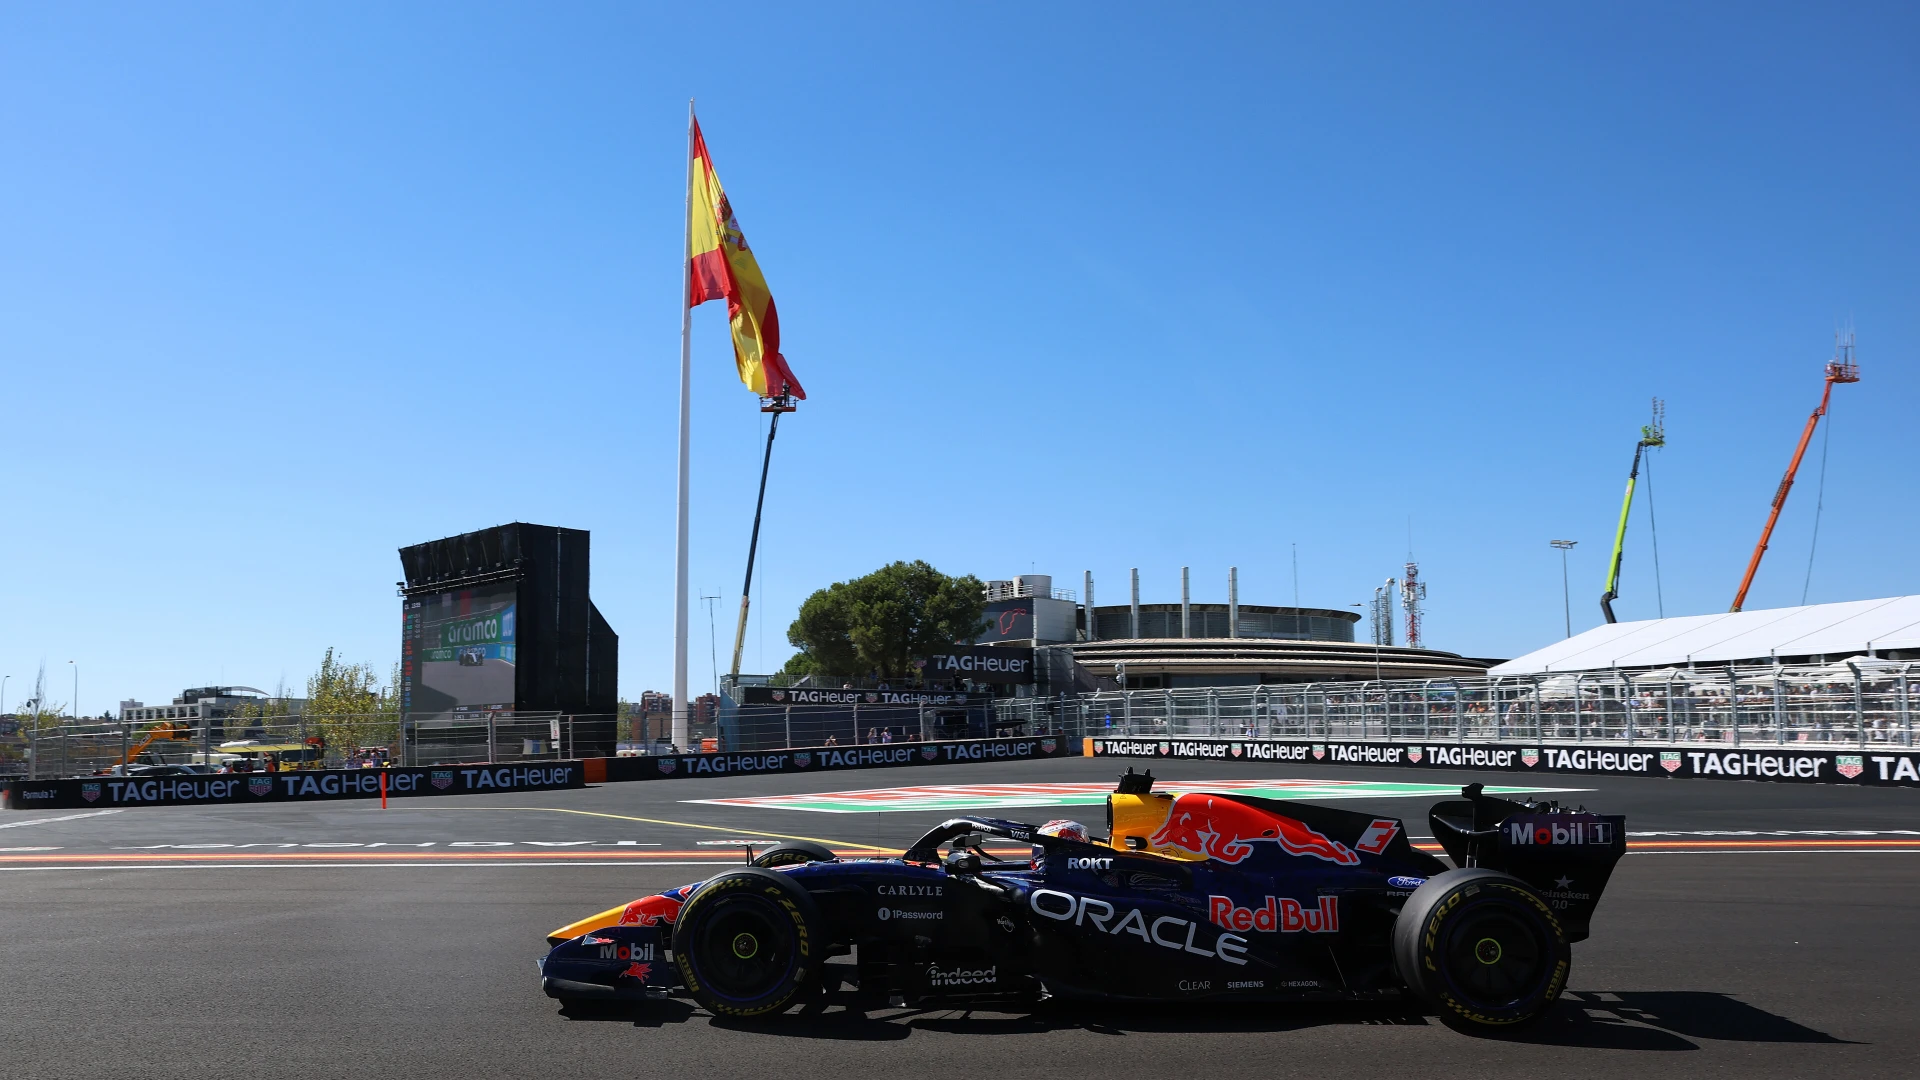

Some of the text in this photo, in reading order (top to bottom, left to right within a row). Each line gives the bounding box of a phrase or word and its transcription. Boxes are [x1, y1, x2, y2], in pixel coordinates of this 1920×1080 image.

[448, 618, 497, 643] aramco
[789, 690, 862, 703] TAGHeuer
[816, 748, 916, 767] TAGHeuer
[943, 741, 1036, 760] TAGHeuer
[1105, 741, 1157, 755] TAGHeuer
[1171, 742, 1229, 757] TAGHeuer
[1244, 743, 1309, 760] TAGHeuer
[1328, 744, 1404, 762] TAGHeuer
[1426, 746, 1516, 766] TAGHeuer
[682, 755, 788, 773] TAGHeuer
[1544, 749, 1654, 771] TAGHeuer
[1687, 752, 1827, 778] TAGHeuer
[1840, 757, 1861, 765] TAG
[1871, 756, 1920, 781] TA
[461, 767, 572, 789] TAGHeuer
[22, 789, 49, 800] Formula
[108, 779, 240, 802] TAGHeuer
[1010, 829, 1030, 840] VISA
[1358, 819, 1400, 855] 3
[1510, 822, 1604, 845] Mobil 1
[1067, 857, 1114, 870] ROKT
[877, 885, 943, 896] CARLYLE
[1396, 877, 1422, 887] Ford
[1538, 889, 1590, 900] eineken
[764, 886, 782, 895] P
[778, 897, 809, 957] ZERO
[892, 909, 943, 920] 1Password
[1209, 894, 1277, 933] Red
[1278, 895, 1339, 933] Bull
[1030, 888, 1248, 966] ORACLE
[1425, 891, 1461, 972] P ZERO
[599, 942, 654, 961] Mobil
[676, 953, 700, 993] PIRELLI
[930, 965, 997, 986] indeed
[1544, 959, 1568, 1002] PIRELLI
[1178, 979, 1212, 991] CLEAR
[1227, 980, 1264, 989] SIEMENS
